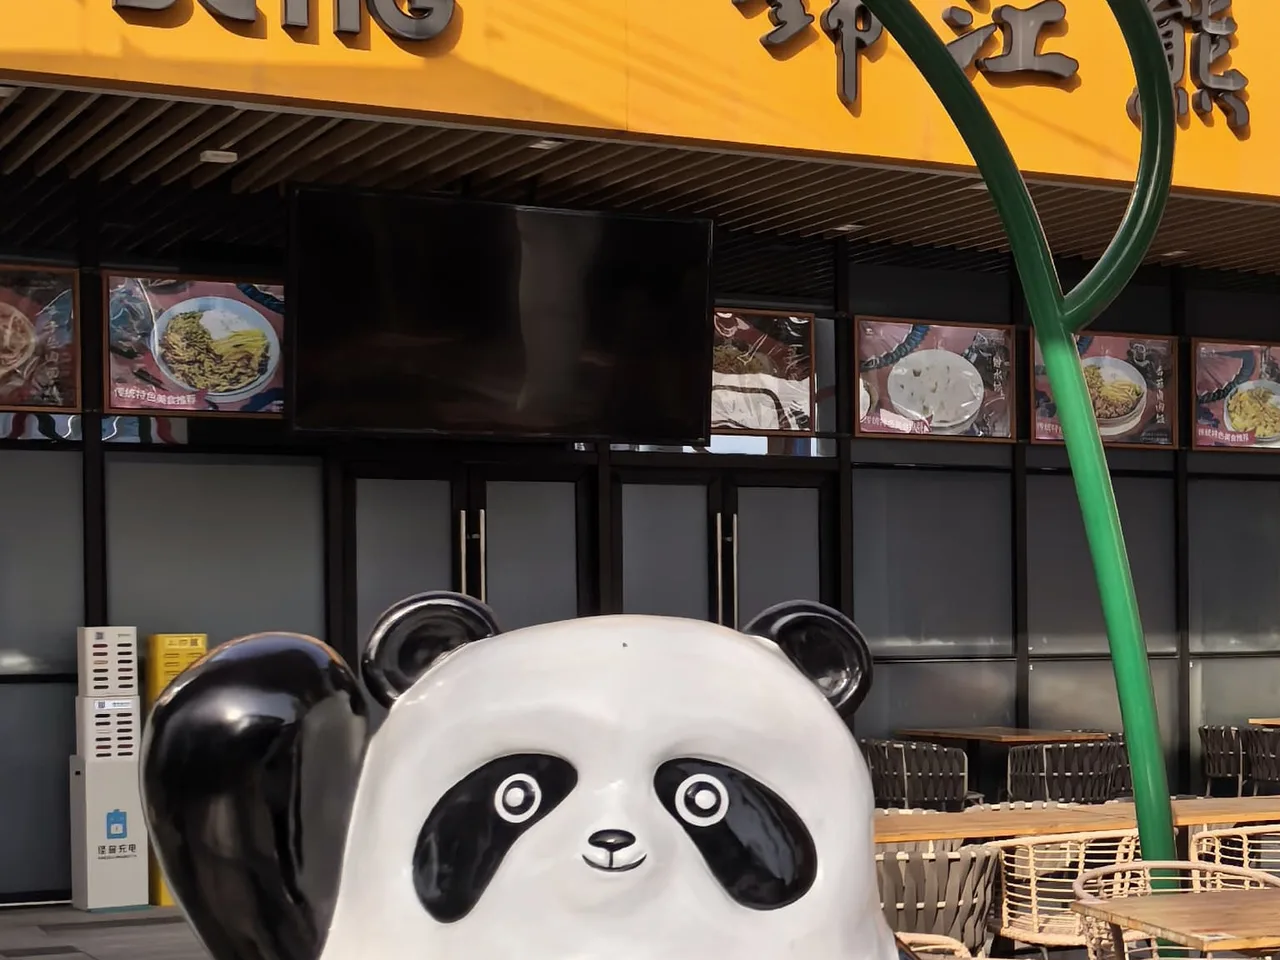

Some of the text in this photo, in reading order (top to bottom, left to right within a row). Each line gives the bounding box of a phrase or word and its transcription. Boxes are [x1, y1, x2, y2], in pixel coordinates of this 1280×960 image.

[113, 387, 196, 405] 传统特色美食推荐
